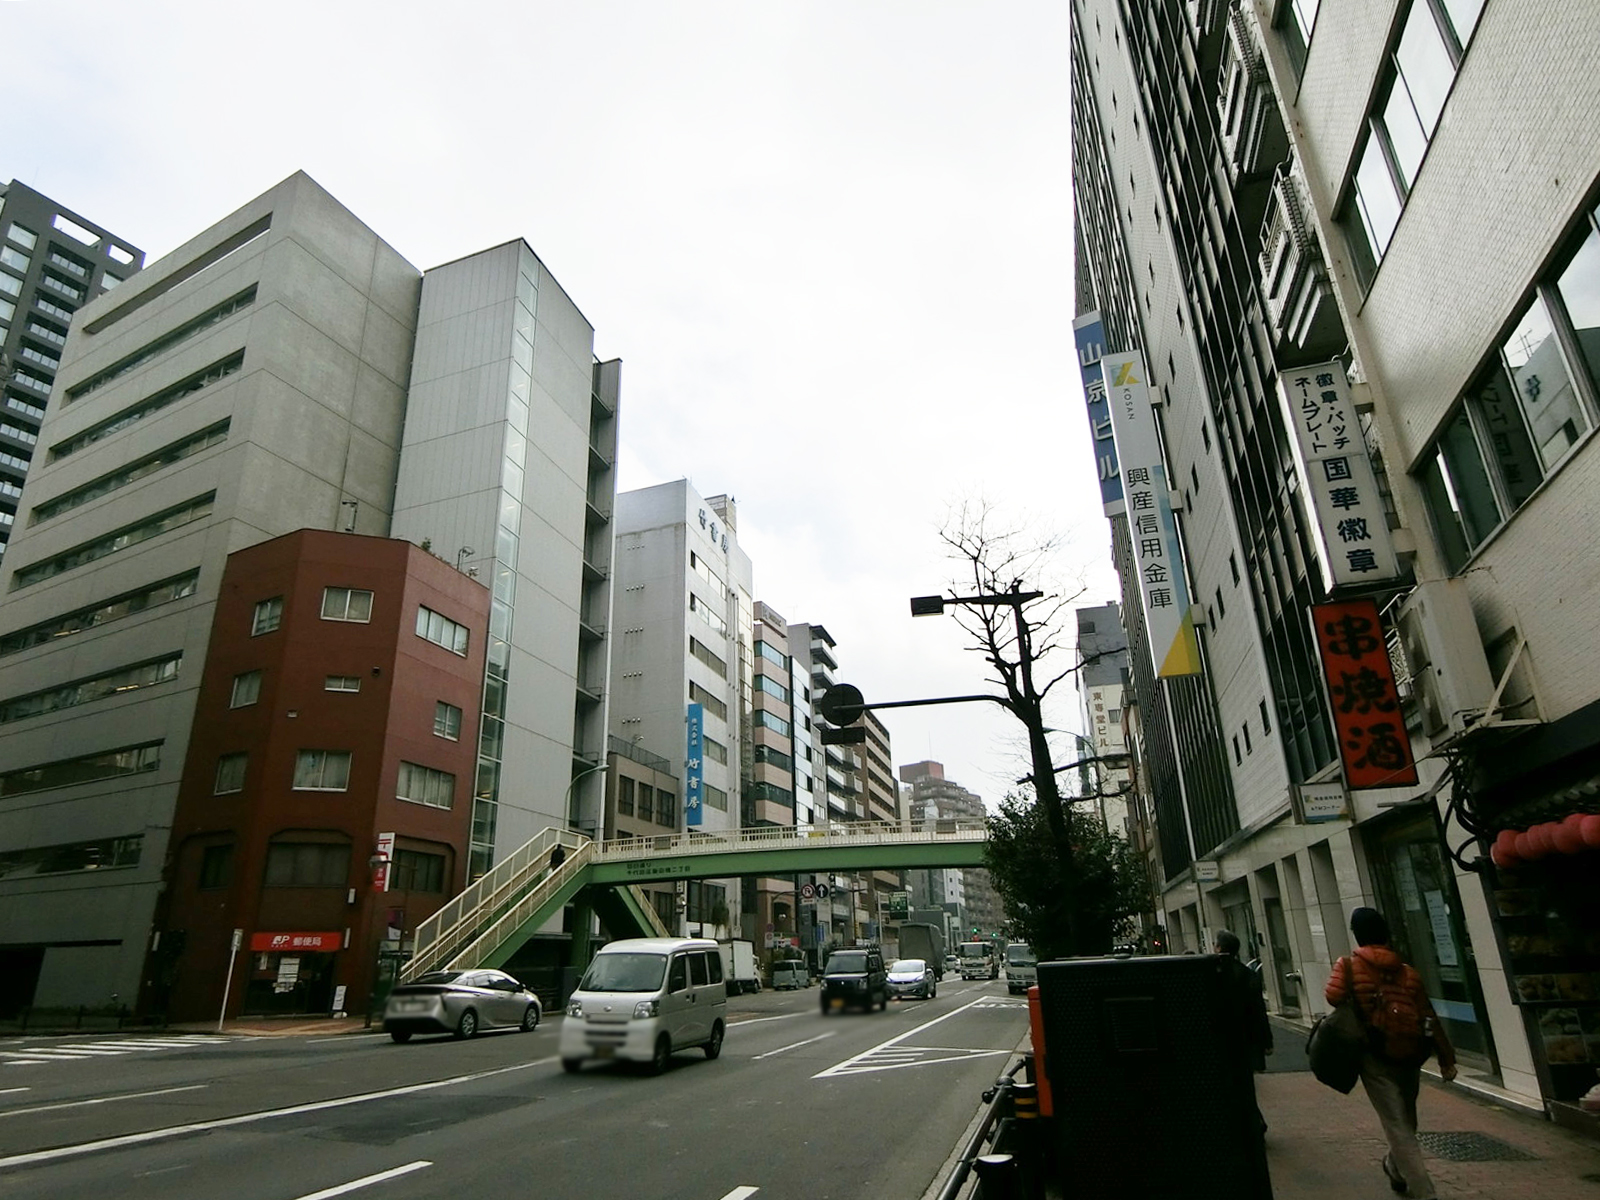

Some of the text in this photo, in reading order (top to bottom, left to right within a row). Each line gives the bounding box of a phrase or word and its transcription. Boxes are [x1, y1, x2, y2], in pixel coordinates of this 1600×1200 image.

[1080, 342, 1119, 481] 山京ビル
[1122, 388, 1135, 420] KOSAN
[1294, 377, 1327, 454] ネームプレート
[1127, 467, 1173, 609] 興産信用金庫
[1322, 456, 1378, 574] 国華徽章
[687, 758, 700, 809] 竹書房
[293, 936, 322, 947] 郵便局
